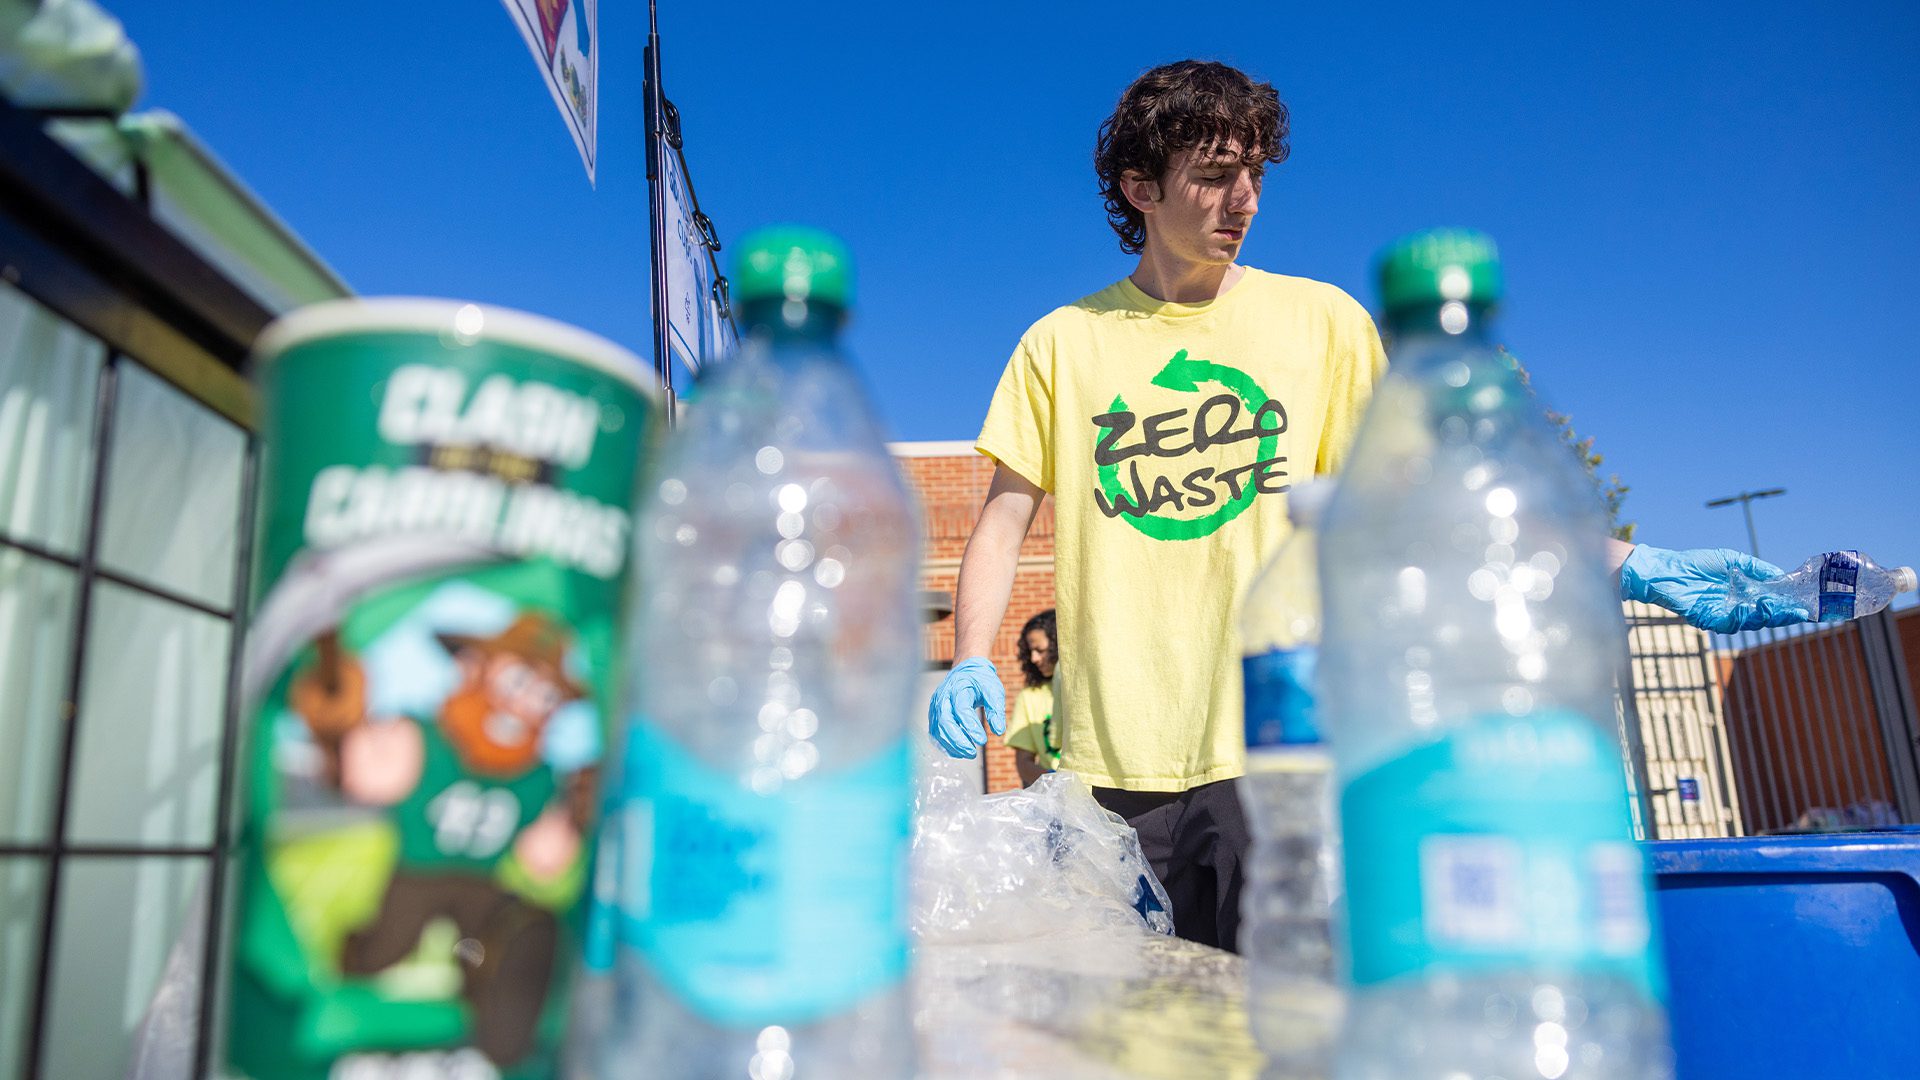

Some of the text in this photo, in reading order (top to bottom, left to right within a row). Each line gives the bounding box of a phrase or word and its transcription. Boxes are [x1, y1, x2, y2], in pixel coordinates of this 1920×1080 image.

[378, 364, 600, 470] CLASH
[1092, 394, 1288, 466] ZERO
[1094, 456, 1291, 518] WASTE
